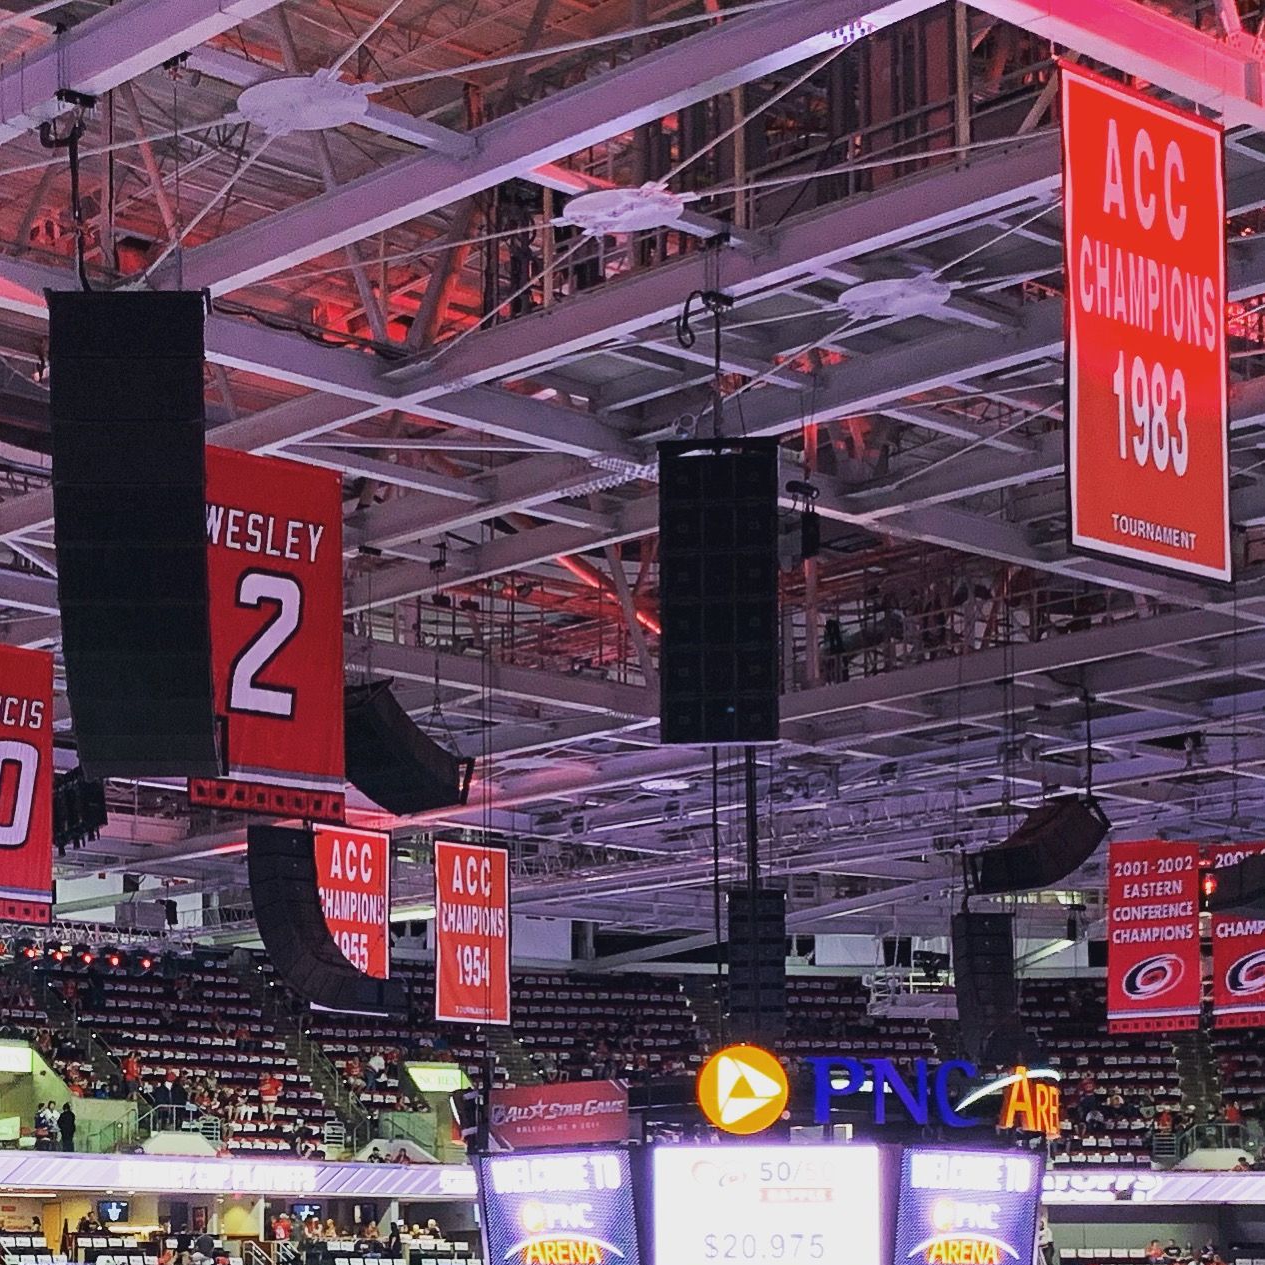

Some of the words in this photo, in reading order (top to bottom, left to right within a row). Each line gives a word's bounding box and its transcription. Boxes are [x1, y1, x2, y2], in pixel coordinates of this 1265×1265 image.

[1102, 117, 1188, 242] ACC
[1078, 234, 1216, 353] CHAMPIONS
[1112, 349, 1189, 478] 1983
[205, 504, 325, 564] WESLEY
[1111, 511, 1198, 551] TOURNAMENT
[229, 571, 302, 717] 2
[330, 839, 373, 883] ACC
[452, 855, 491, 897] ACC
[1113, 855, 1193, 877] 2001-2002
[318, 886, 385, 925] CHAMPIONS
[1123, 879, 1183, 899] EASTERN
[442, 902, 504, 938] CHAMPIONS
[1112, 901, 1193, 921] CONFERENCE
[1112, 924, 1194, 944] CHAMPIONS
[456, 943, 491, 987] 1954
[505, 1106, 529, 1123] ALL
[544, 1101, 583, 1120] STAR
[583, 1099, 626, 1116] GAME
[805, 1055, 983, 1128] PNC
[956, 1202, 1001, 1229] PNC
[525, 1239, 603, 1265] ARENA
[927, 1240, 1000, 1265] ARENA
